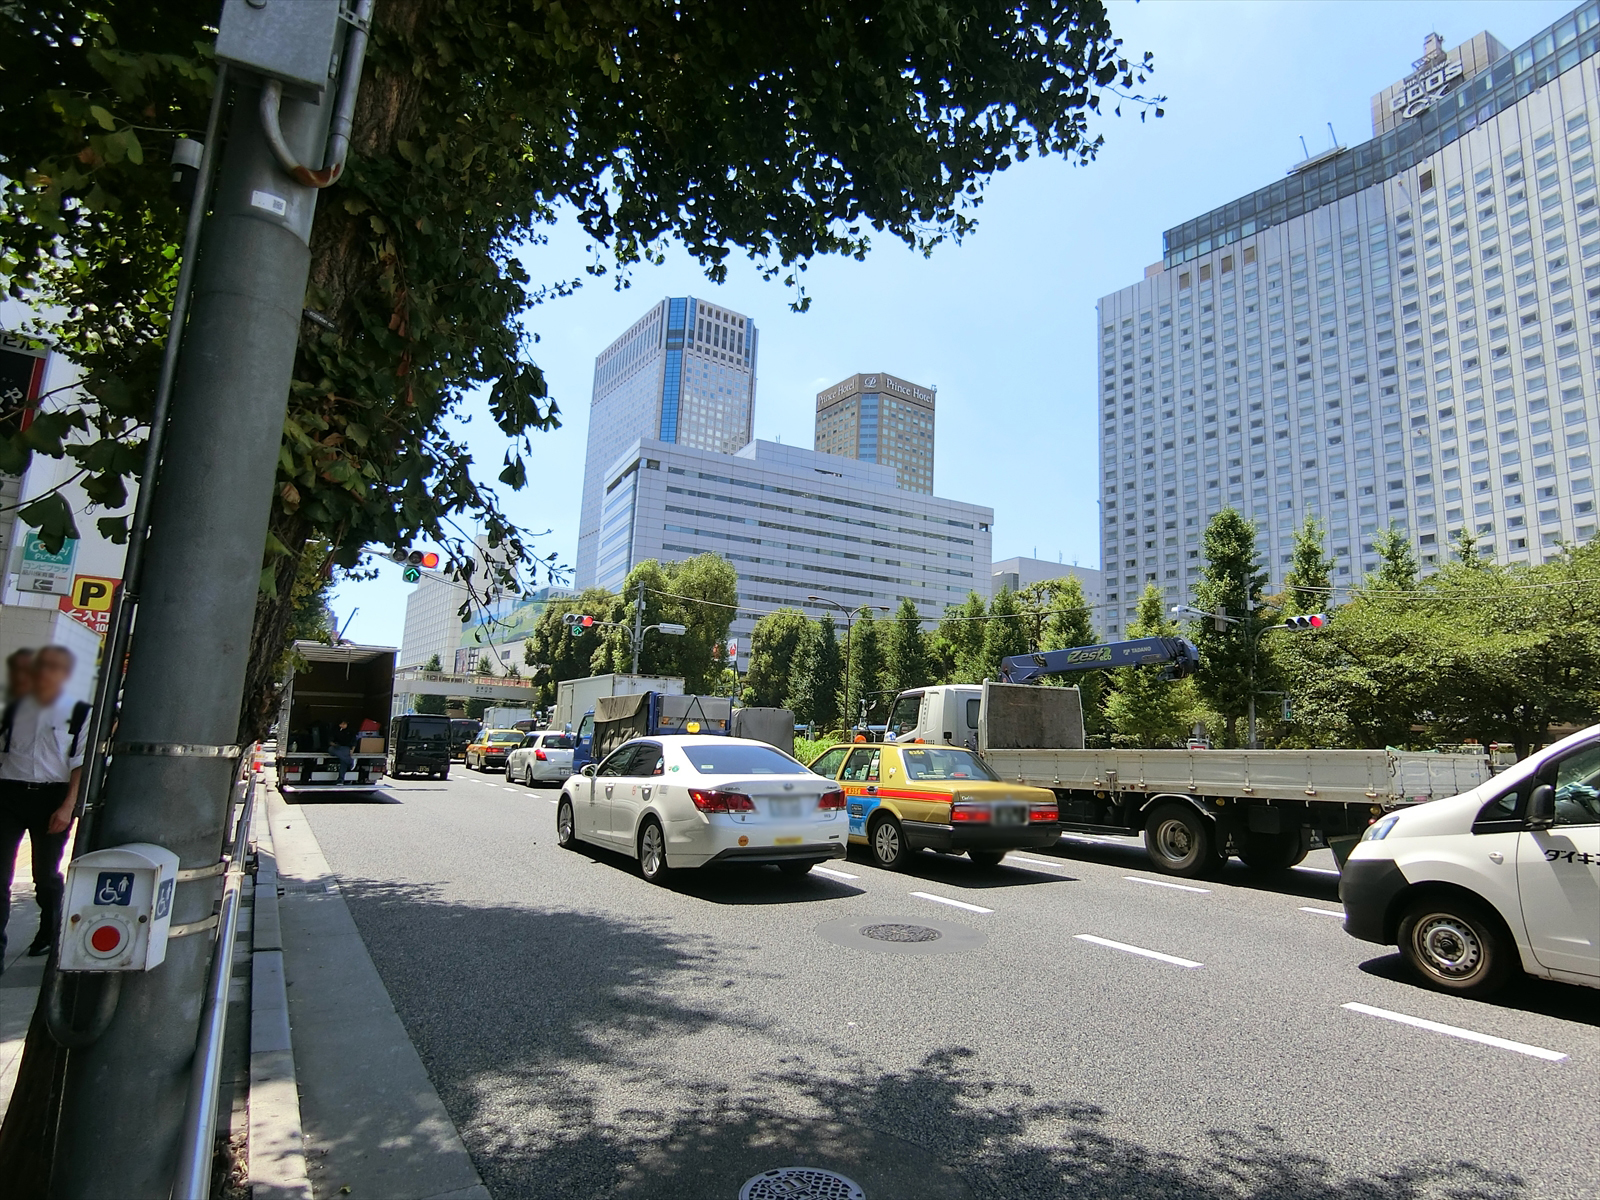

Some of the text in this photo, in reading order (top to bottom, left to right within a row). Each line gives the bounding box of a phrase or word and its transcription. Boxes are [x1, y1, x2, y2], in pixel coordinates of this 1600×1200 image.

[818, 379, 855, 406] Prince Hotel
[886, 378, 933, 403] Prince Hotel
[34, 552, 63, 562] PLAZA
[79, 581, 107, 607] P
[82, 610, 111, 623] 入口
[1068, 648, 1104, 663] Zest
